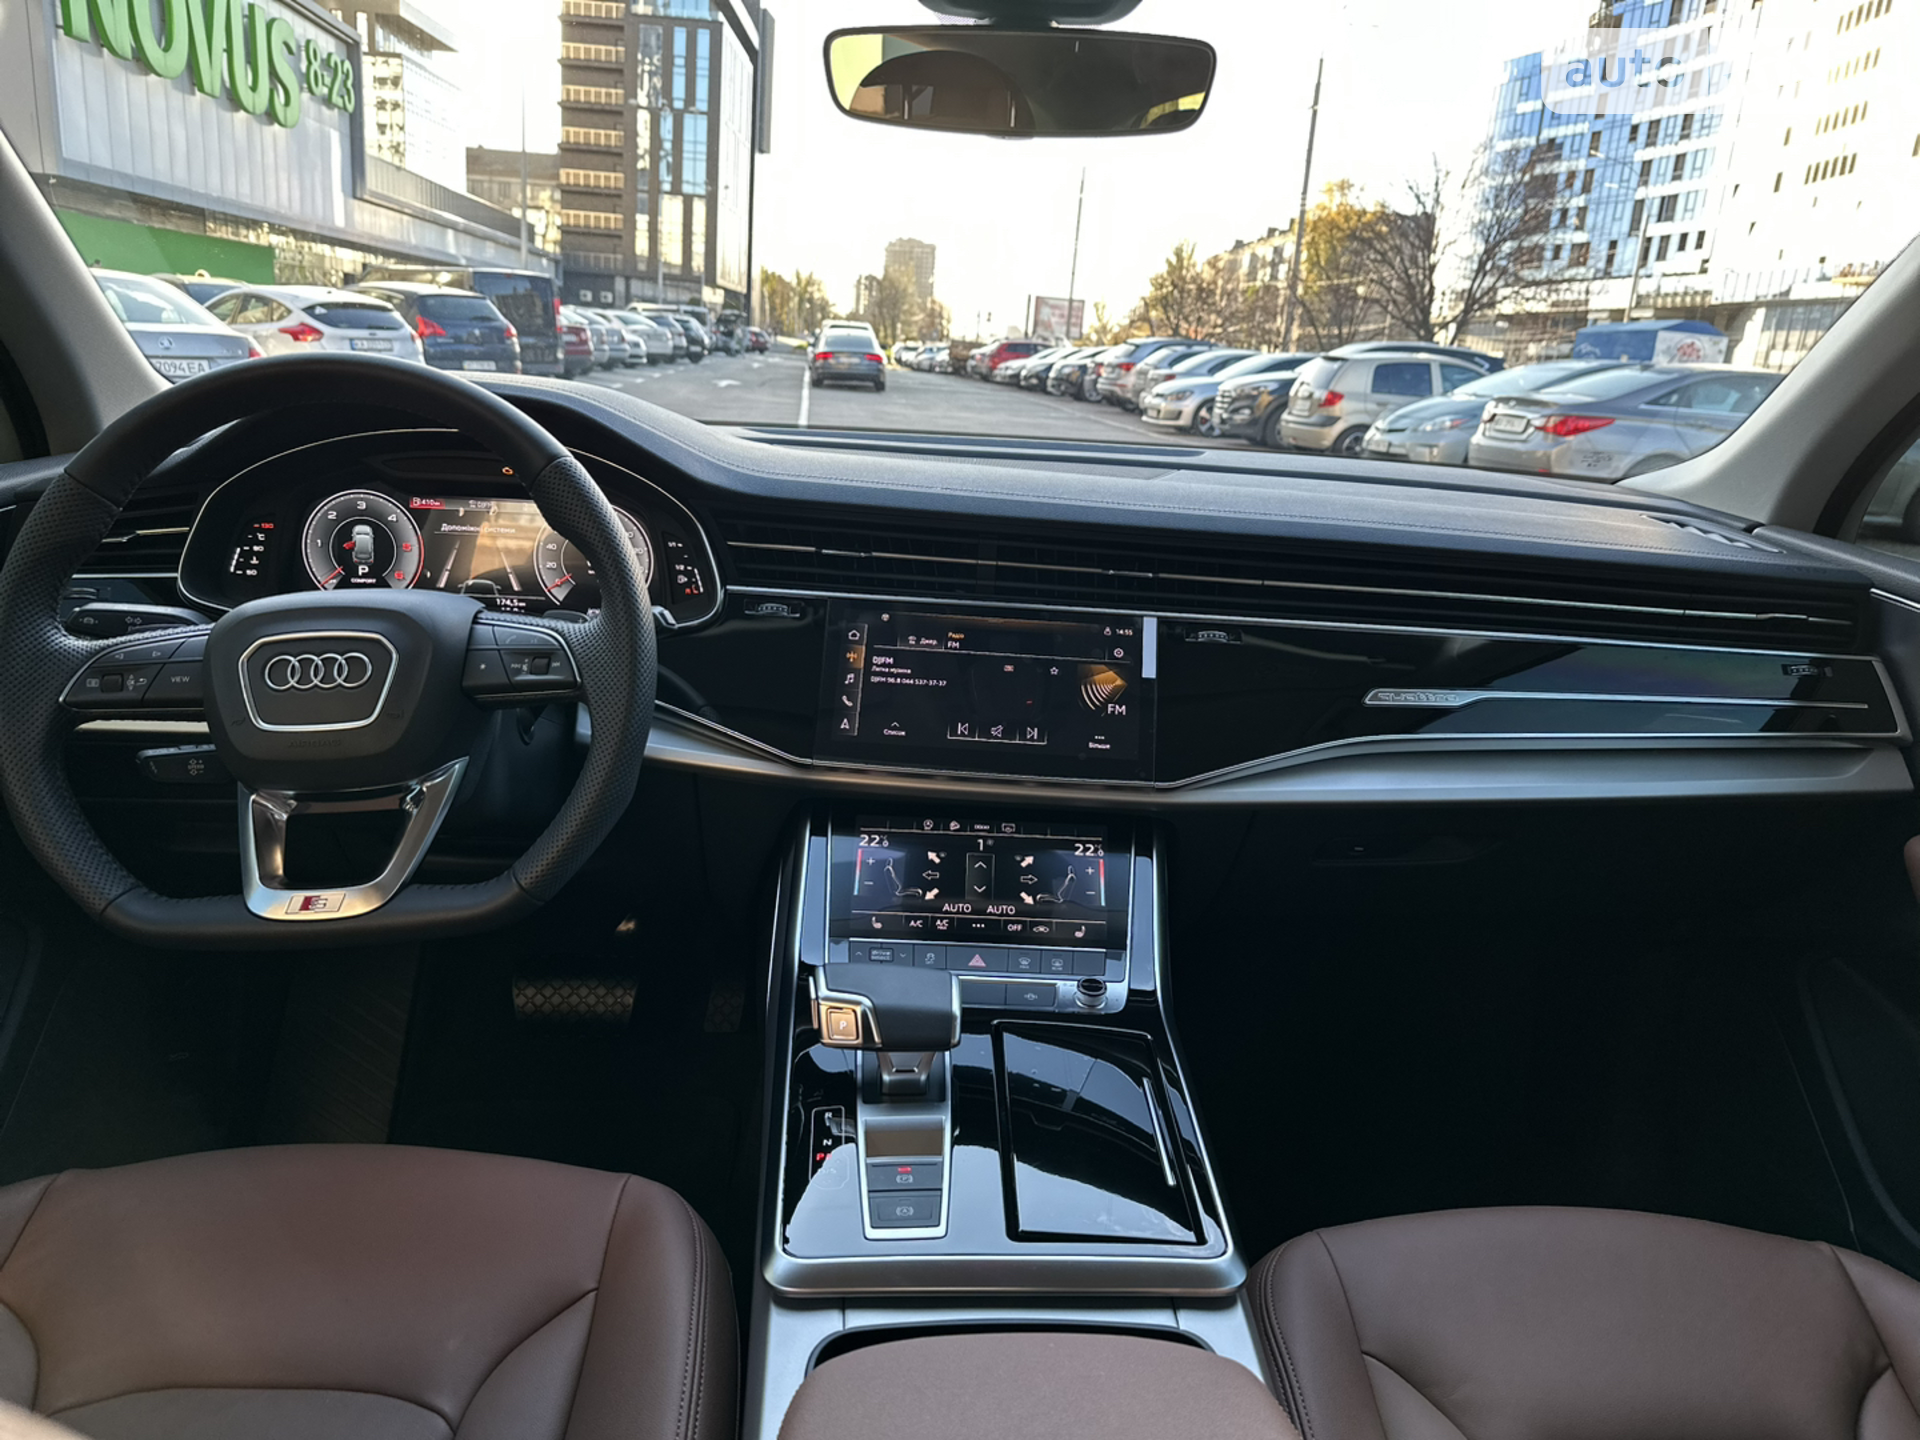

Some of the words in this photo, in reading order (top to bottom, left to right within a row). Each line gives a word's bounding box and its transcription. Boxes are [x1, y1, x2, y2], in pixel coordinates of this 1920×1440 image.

[61, 0, 299, 129] NOVUS
[305, 38, 356, 114] 8-23
[356, 501, 367, 510] 3
[327, 511, 337, 520] 2
[387, 513, 397, 522] 4
[316, 538, 322, 548] 1
[358, 565, 370, 577] P
[947, 641, 960, 649] FM
[170, 675, 191, 683] VIEW
[1107, 703, 1127, 716] FM
[942, 903, 972, 913] AUTO
[986, 905, 1016, 915] AUTO
[839, 1020, 847, 1030] P
